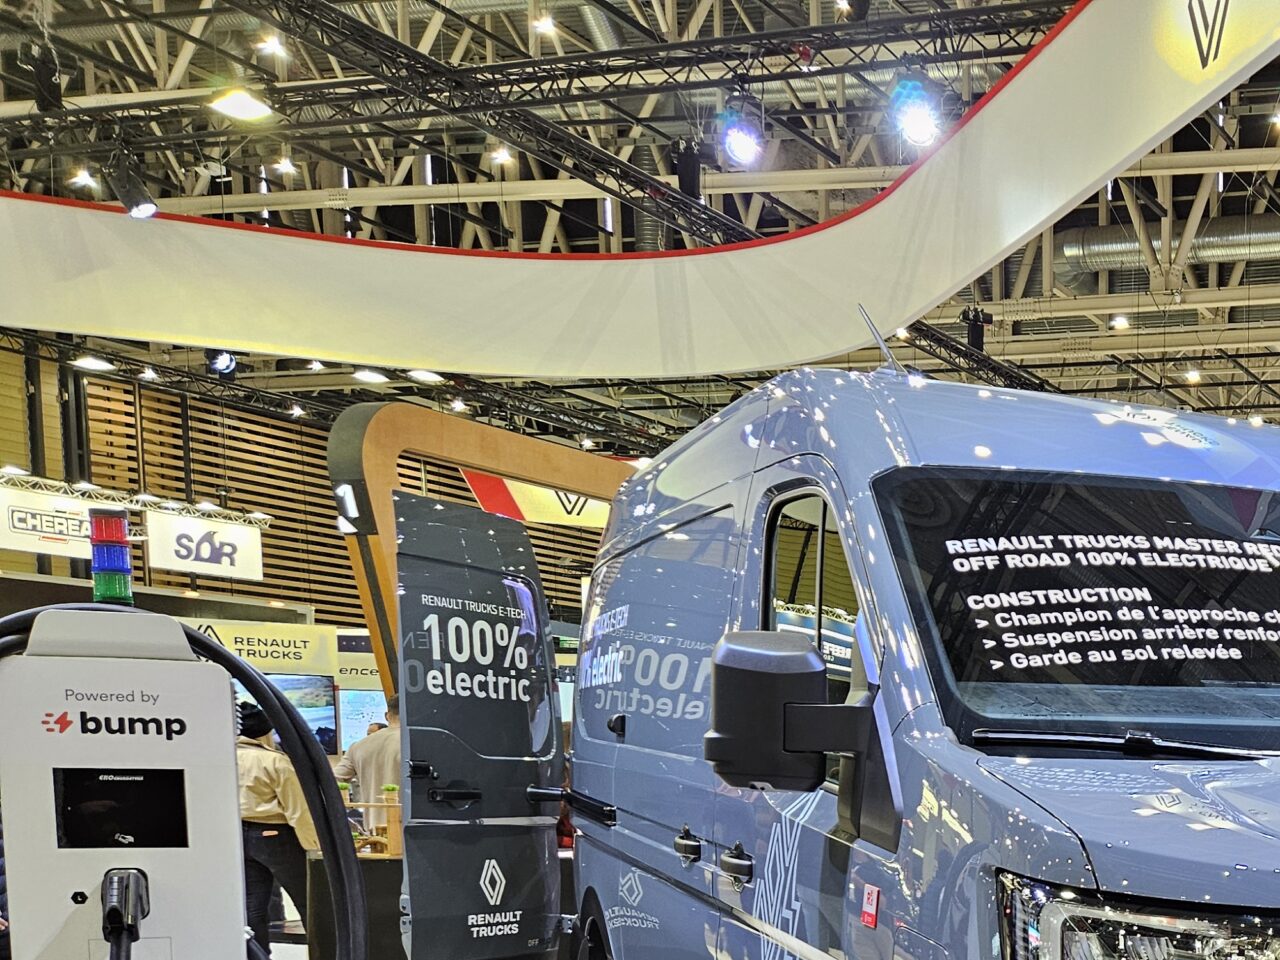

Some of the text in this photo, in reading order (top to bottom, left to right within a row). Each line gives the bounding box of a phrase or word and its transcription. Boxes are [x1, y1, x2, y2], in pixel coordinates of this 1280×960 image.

[11, 509, 92, 539] CHEREA
[945, 535, 1054, 554] RENAULT
[1058, 534, 1150, 550] TRUCKS
[1153, 536, 1242, 554] MASTER
[952, 551, 1273, 572] OFF ROAD 100% ELECTRIQUE
[421, 594, 527, 619] RENAULT TRUCKS E-TECH
[967, 587, 1152, 610] CONSTRUCTION
[994, 608, 1113, 628] Champion
[1117, 607, 1145, 621] de
[1148, 606, 1260, 623] l'approche
[234, 636, 310, 649] RENAULT
[423, 614, 528, 670] 100%
[1001, 627, 1138, 649] Suspension
[1142, 624, 1219, 640] arrière
[234, 648, 303, 660] TRUCKS
[1010, 649, 1083, 669] Garde
[1087, 649, 1117, 663] au
[1121, 645, 1158, 661] sol
[1161, 643, 1243, 660] relevée
[426, 663, 531, 702] electric
[65, 688, 160, 706] Powered by
[80, 711, 187, 741] bump
[468, 910, 523, 926] RENAULT
[470, 924, 519, 938] TRUCKS
